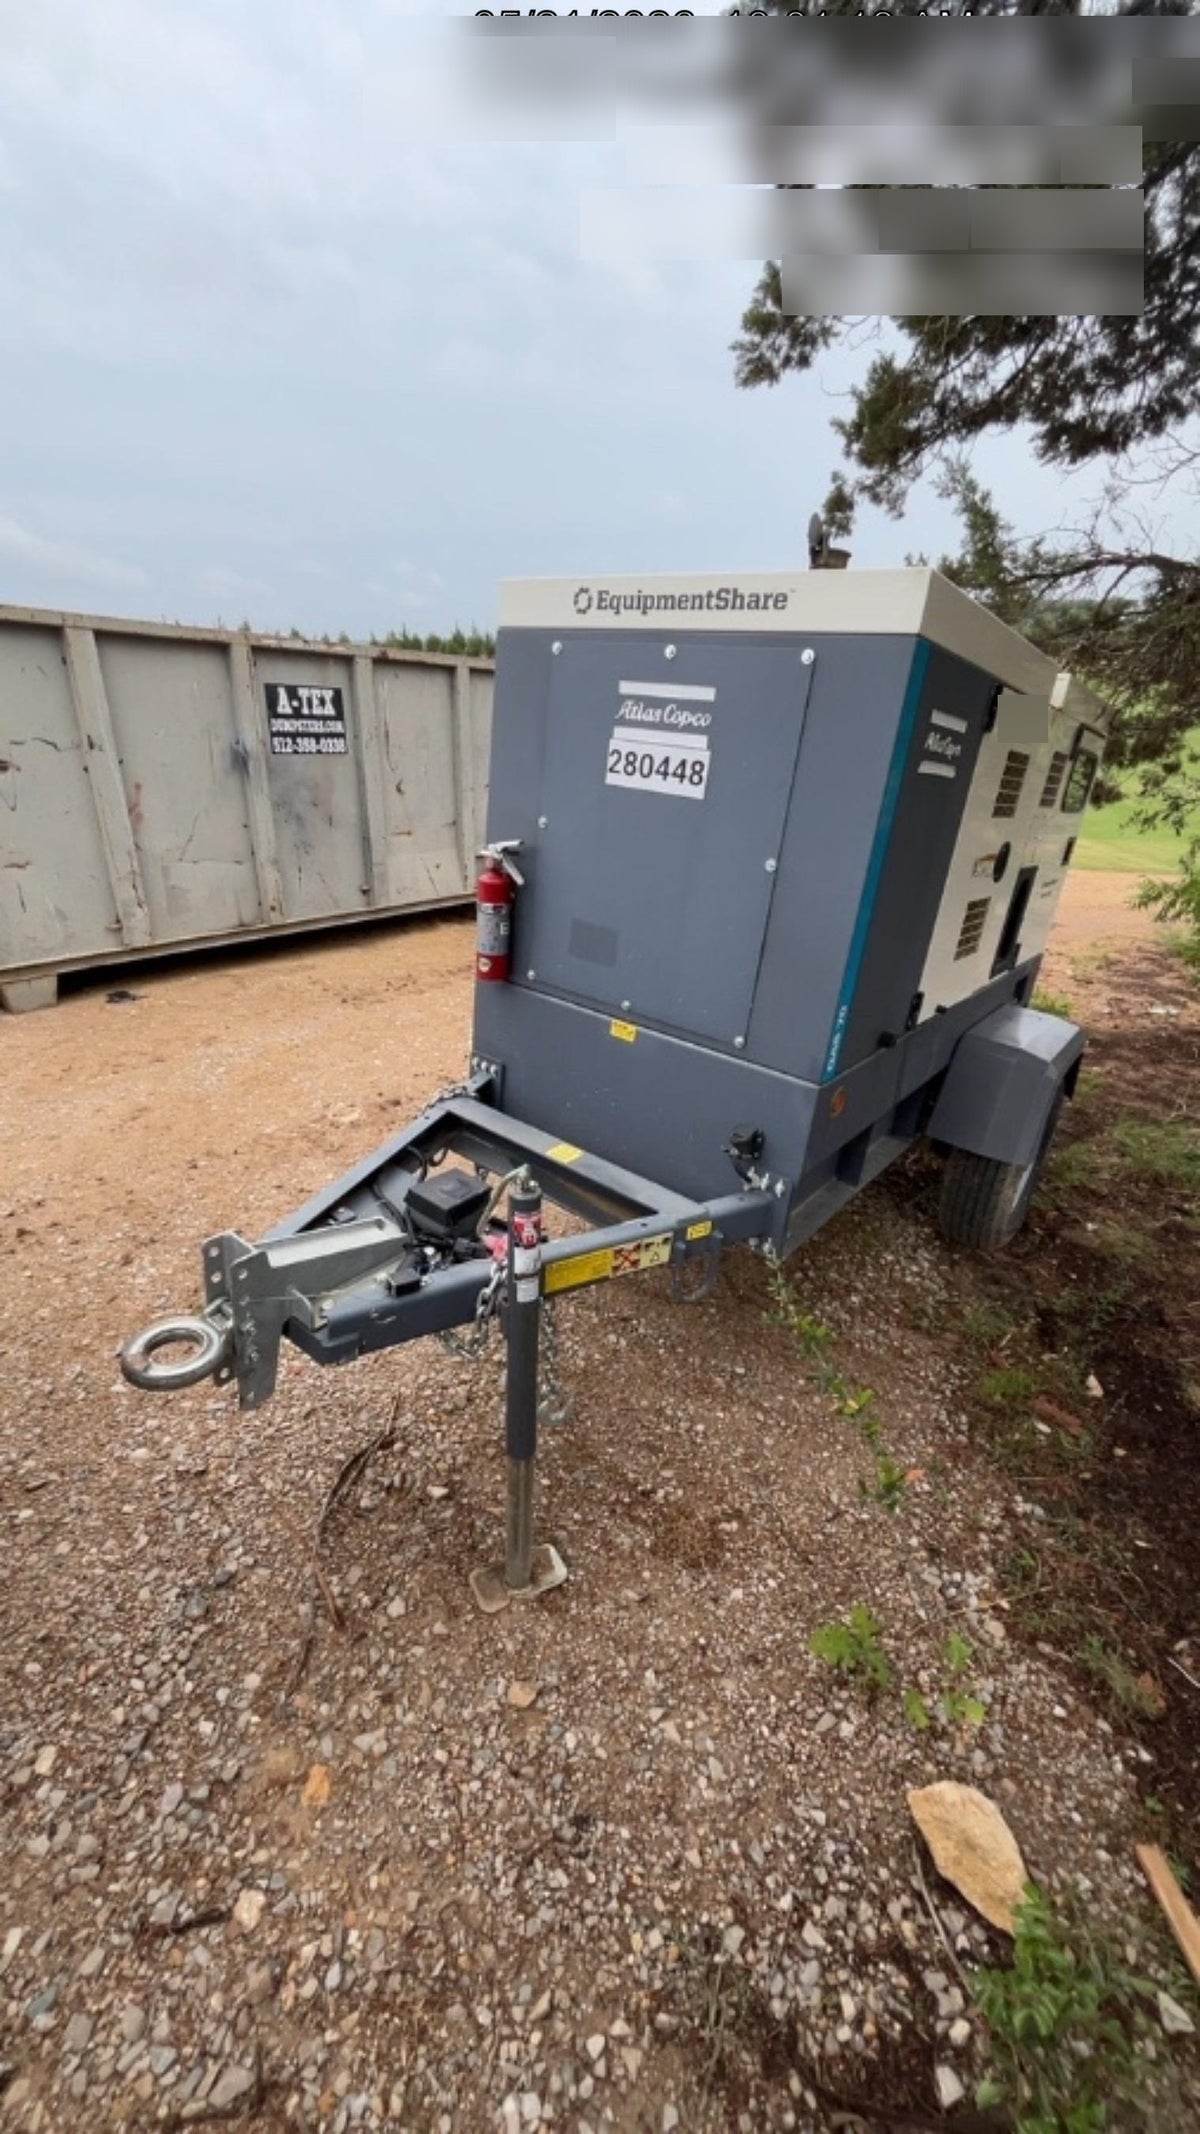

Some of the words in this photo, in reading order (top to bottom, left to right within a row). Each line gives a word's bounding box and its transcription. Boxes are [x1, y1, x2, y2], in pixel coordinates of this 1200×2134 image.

[597, 587, 788, 614] EquipmentShare
[277, 687, 336, 716] A-TEX
[615, 699, 661, 722] Atlas
[663, 703, 712, 728] Copco
[608, 749, 705, 787] 280448
